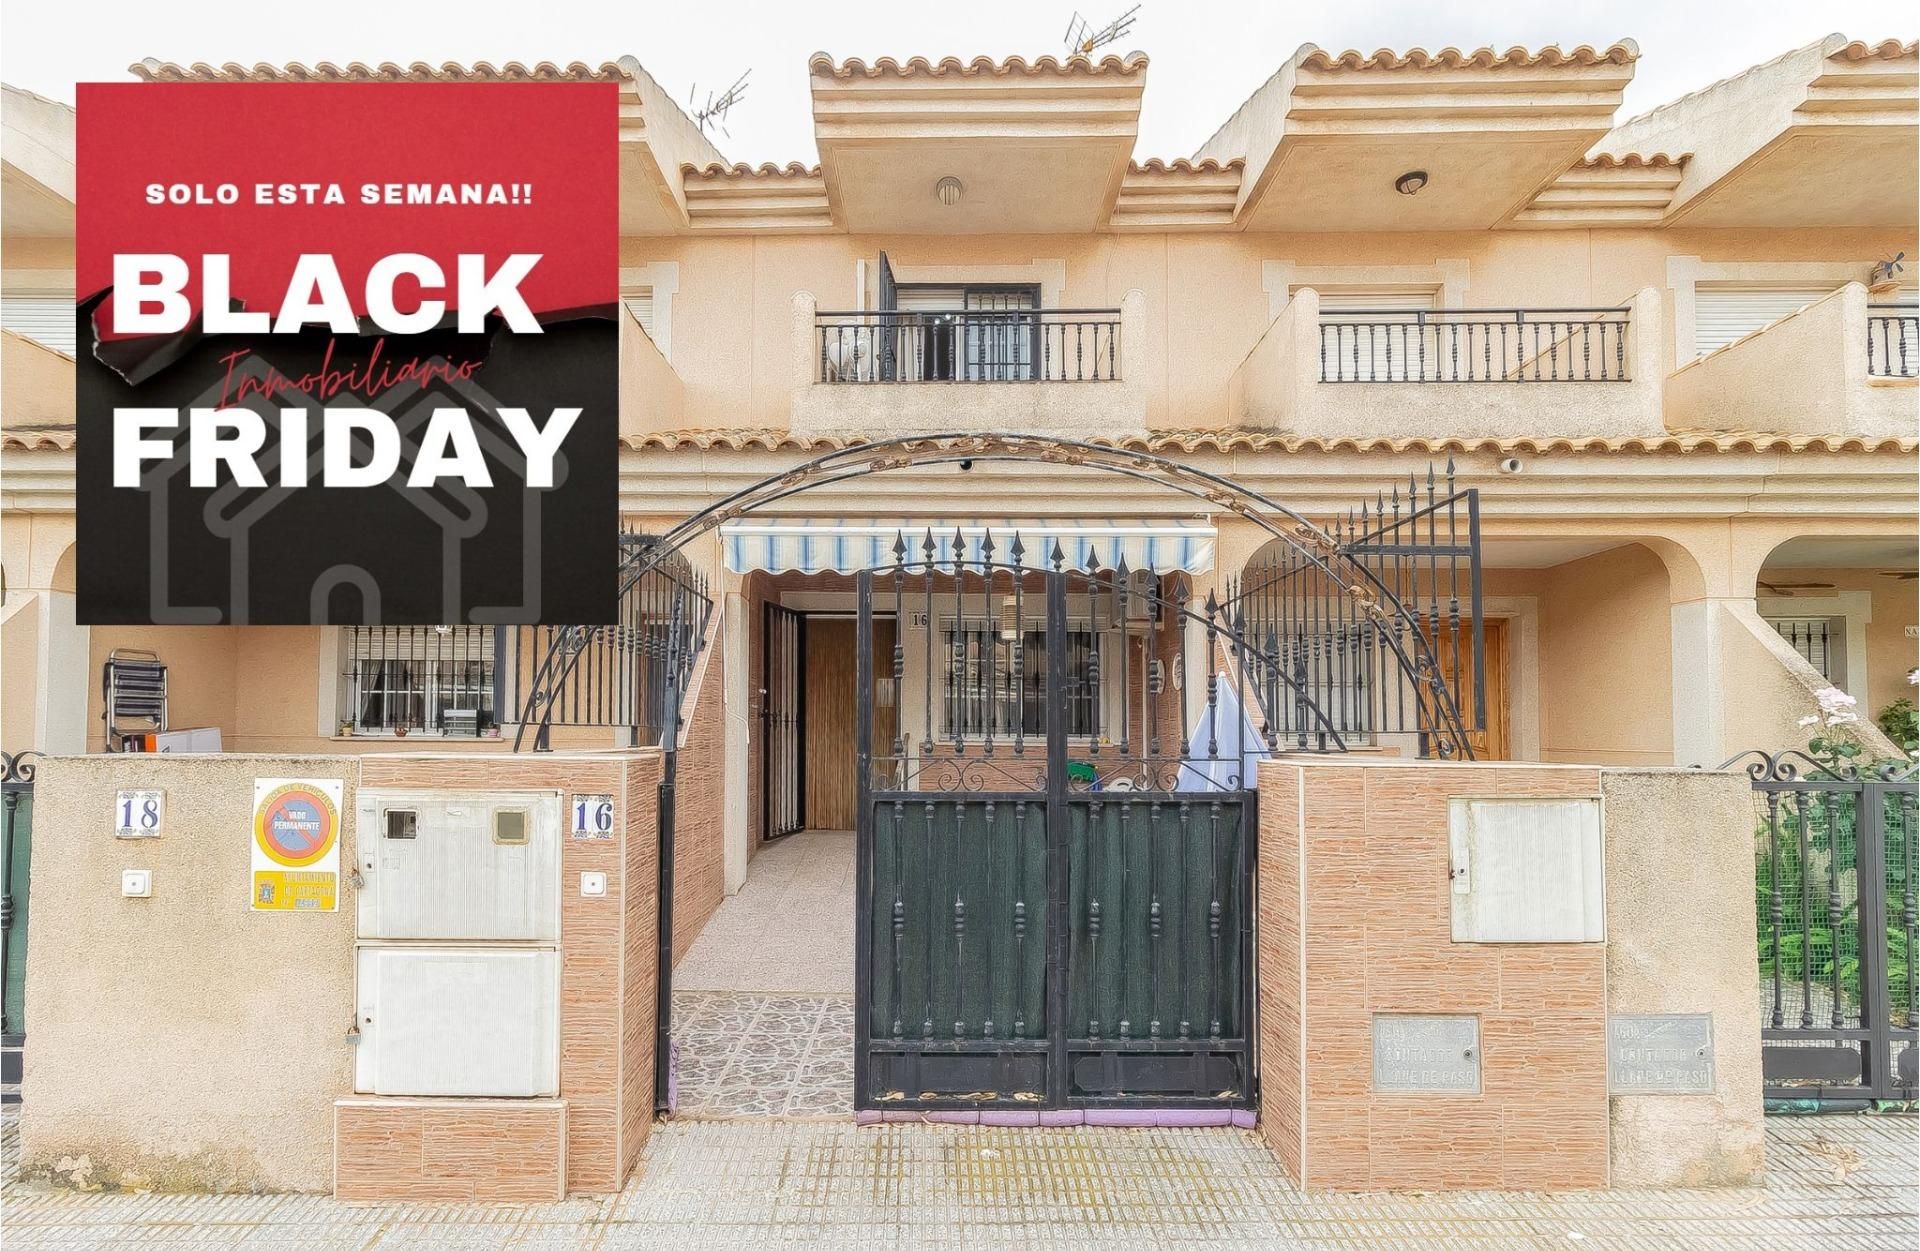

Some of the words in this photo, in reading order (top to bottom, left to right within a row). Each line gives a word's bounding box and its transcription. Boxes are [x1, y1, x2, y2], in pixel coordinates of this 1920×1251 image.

[913, 614, 928, 626] 16
[122, 799, 158, 829] 18
[288, 810, 307, 820] VADO
[576, 802, 613, 831] 16
[274, 821, 321, 831] PERMANENTE
